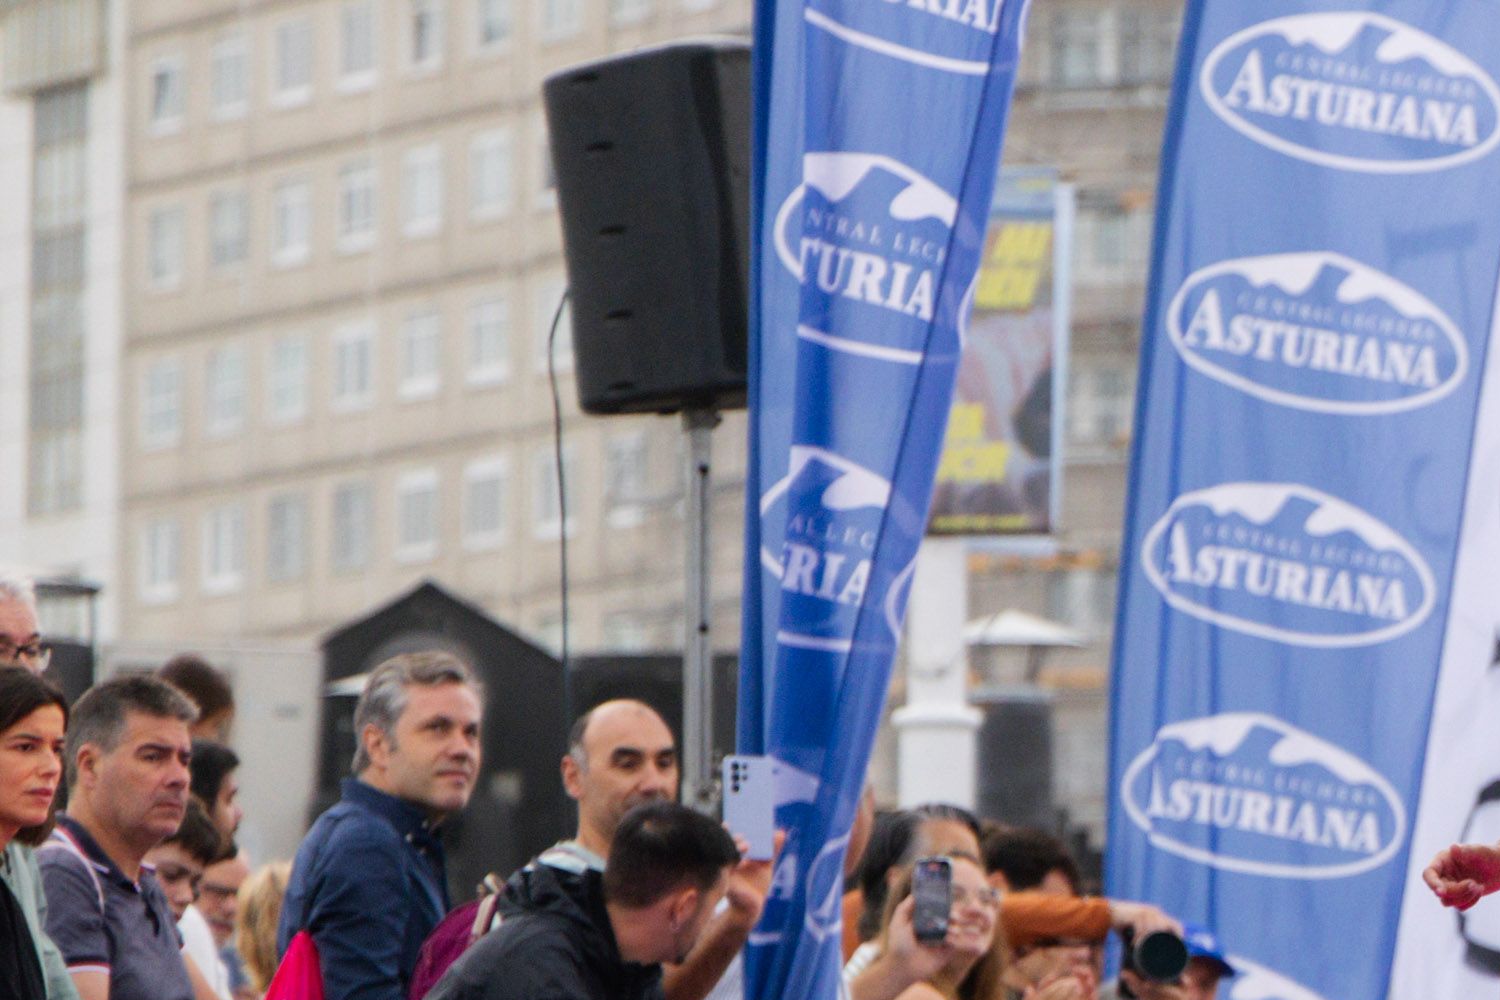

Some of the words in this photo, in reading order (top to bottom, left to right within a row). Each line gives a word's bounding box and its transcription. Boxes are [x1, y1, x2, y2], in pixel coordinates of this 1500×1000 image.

[1224, 48, 1480, 146] ASTURIANA
[1183, 286, 1441, 388] ASTURIANA
[1160, 520, 1409, 621] ASTURIANA
[1146, 762, 1381, 854] ASTURIANA
